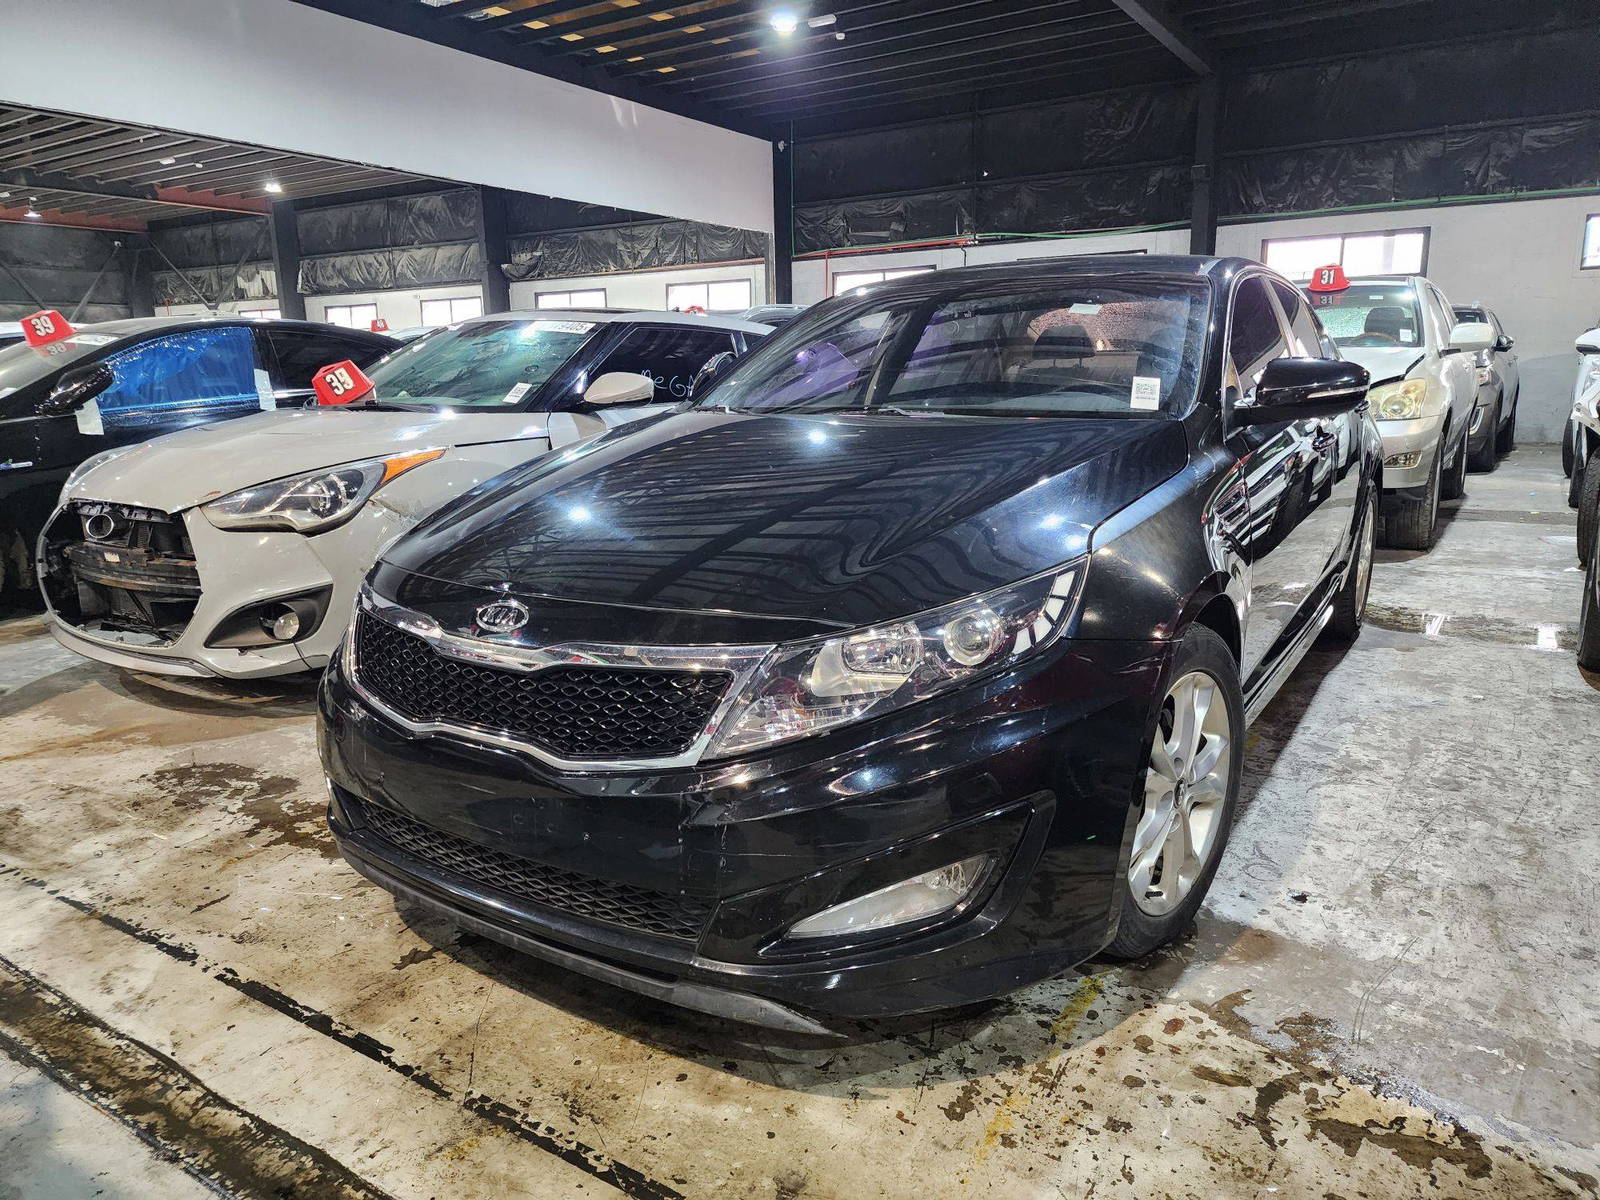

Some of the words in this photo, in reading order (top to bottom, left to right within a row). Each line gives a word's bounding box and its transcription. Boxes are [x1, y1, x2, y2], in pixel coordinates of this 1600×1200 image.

[1320, 269, 1336, 285] 31
[31, 315, 55, 336] 39
[325, 367, 354, 395] 39
